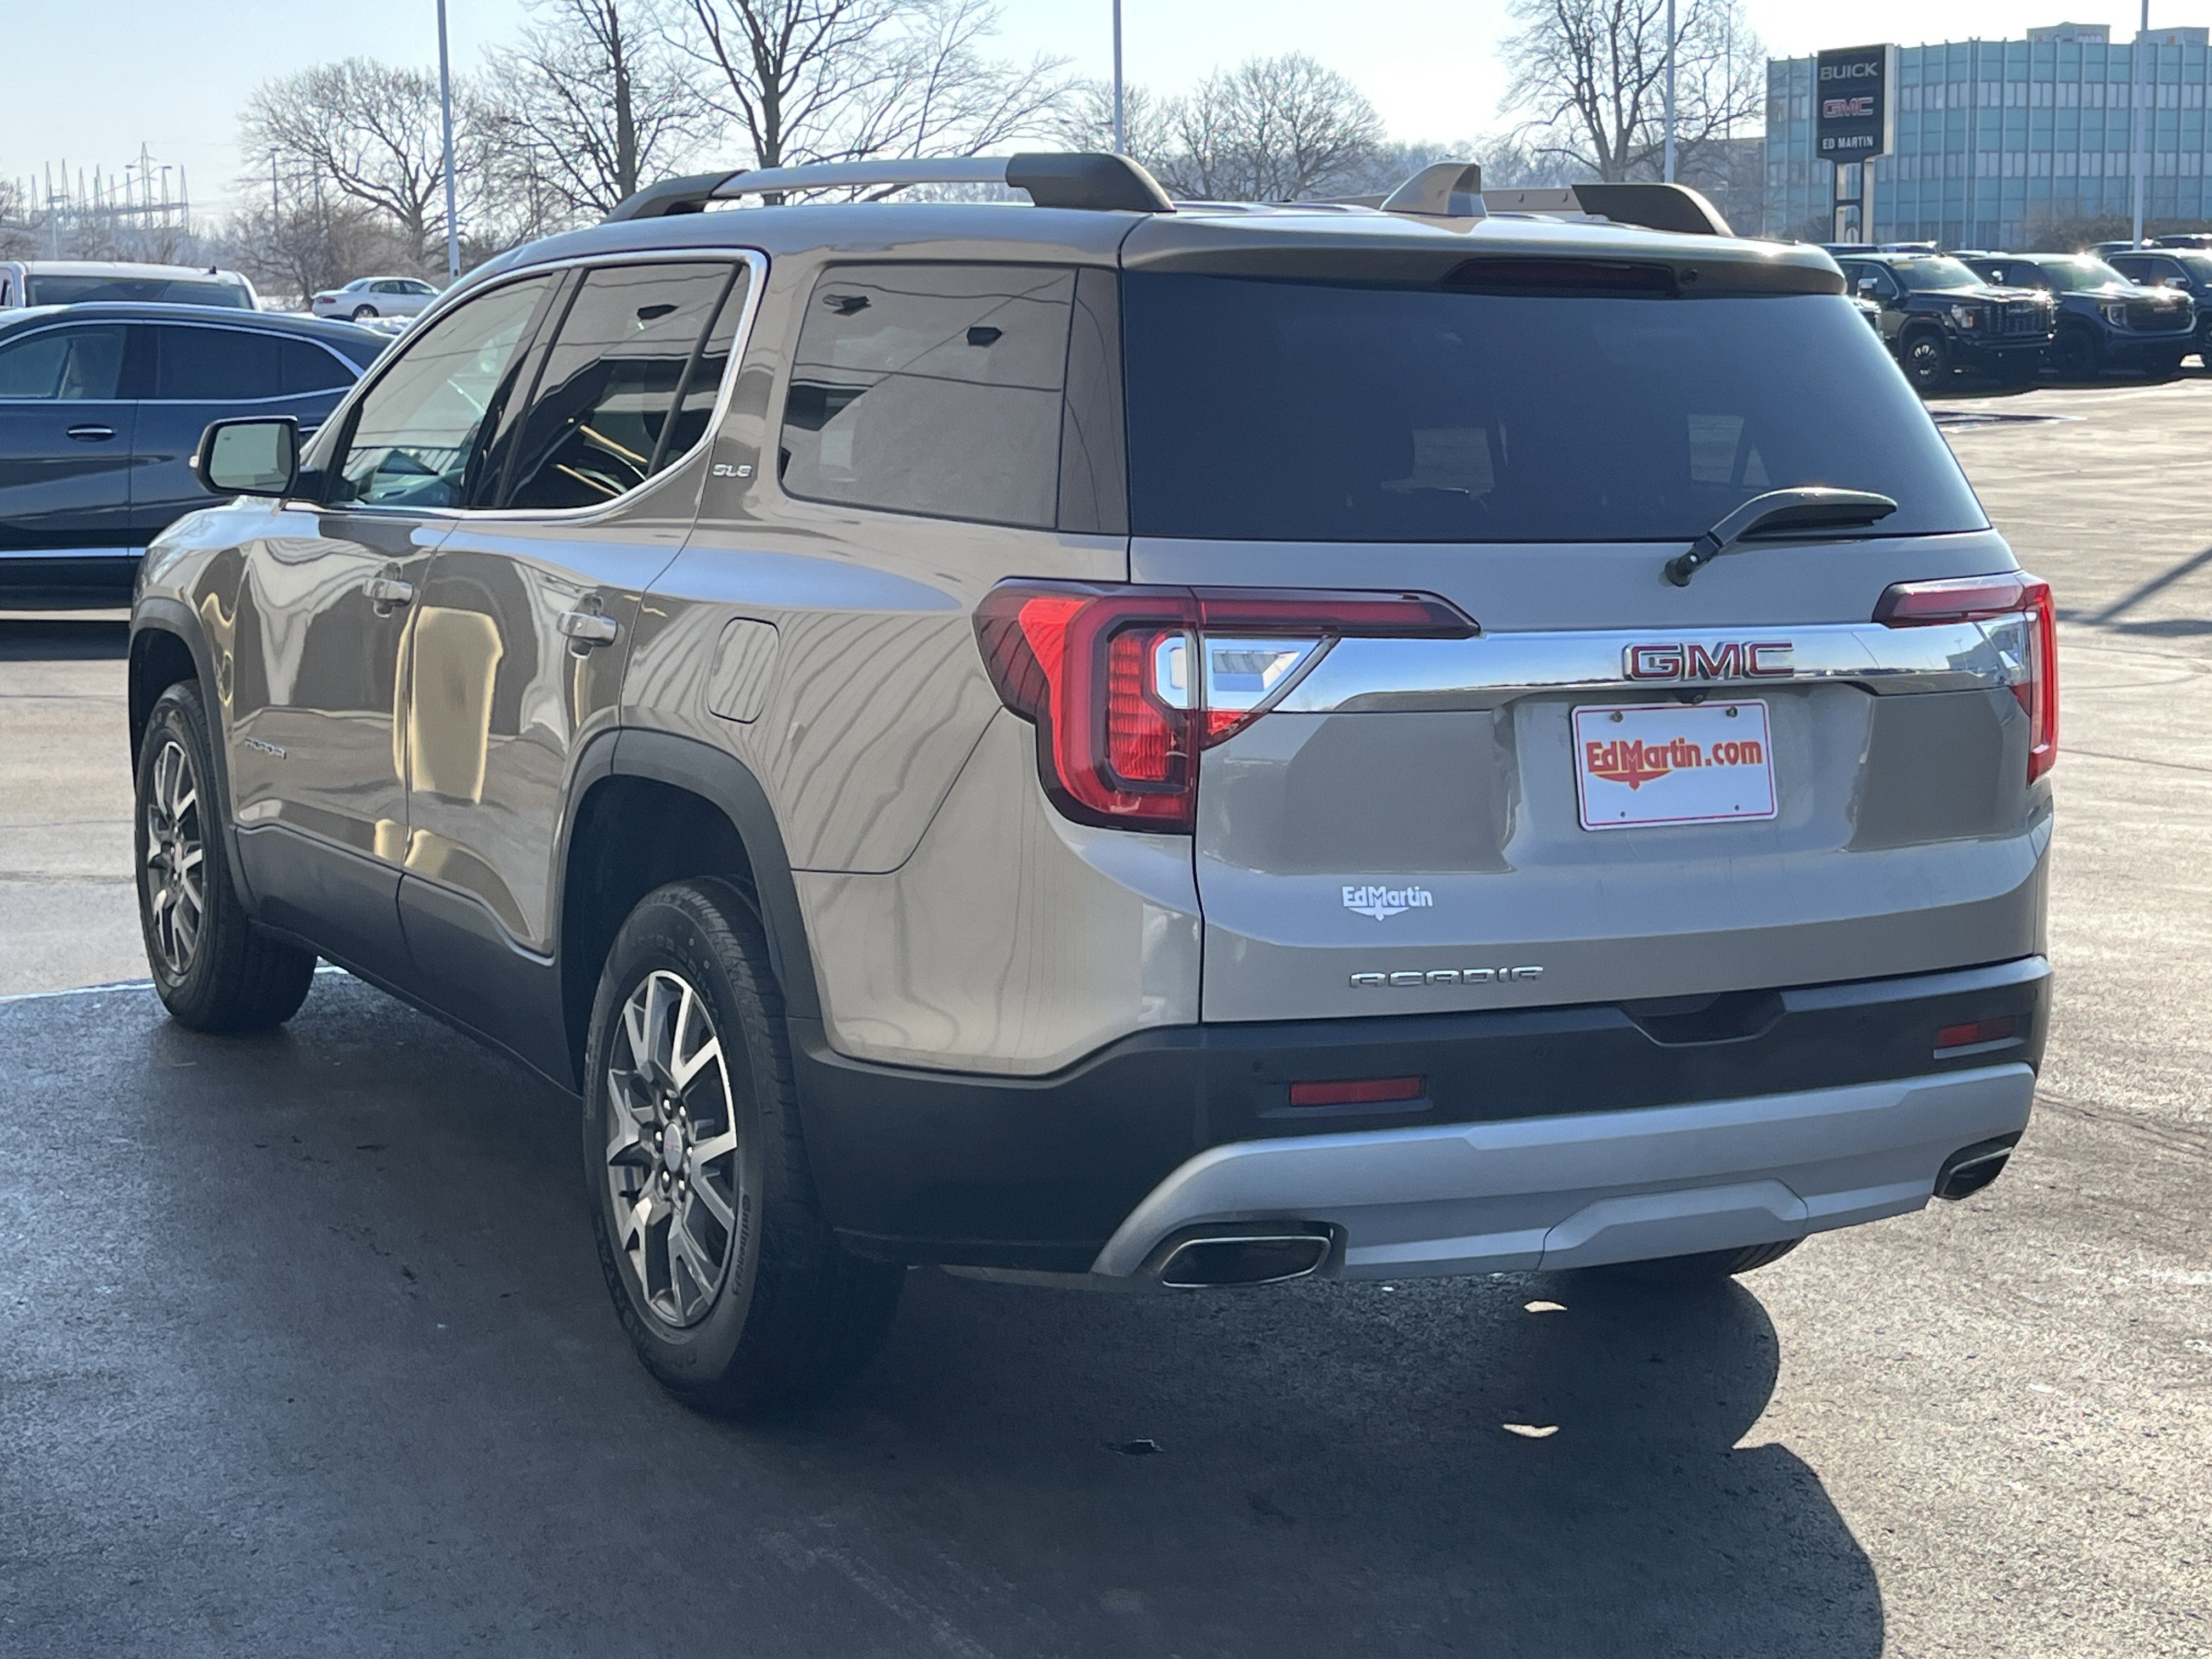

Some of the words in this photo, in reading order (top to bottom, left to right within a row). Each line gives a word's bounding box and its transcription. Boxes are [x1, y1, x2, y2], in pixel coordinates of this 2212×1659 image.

[1819, 62, 1878, 81] BUICK
[1823, 97, 1874, 119] GMC
[1822, 138, 1835, 150] ED
[1838, 136, 1874, 149] MARTIN
[713, 463, 752, 477] SLE
[1622, 641, 1794, 681] GMC
[1585, 737, 1763, 773] EdMartin.com
[1349, 966, 1544, 988] ACADIA
